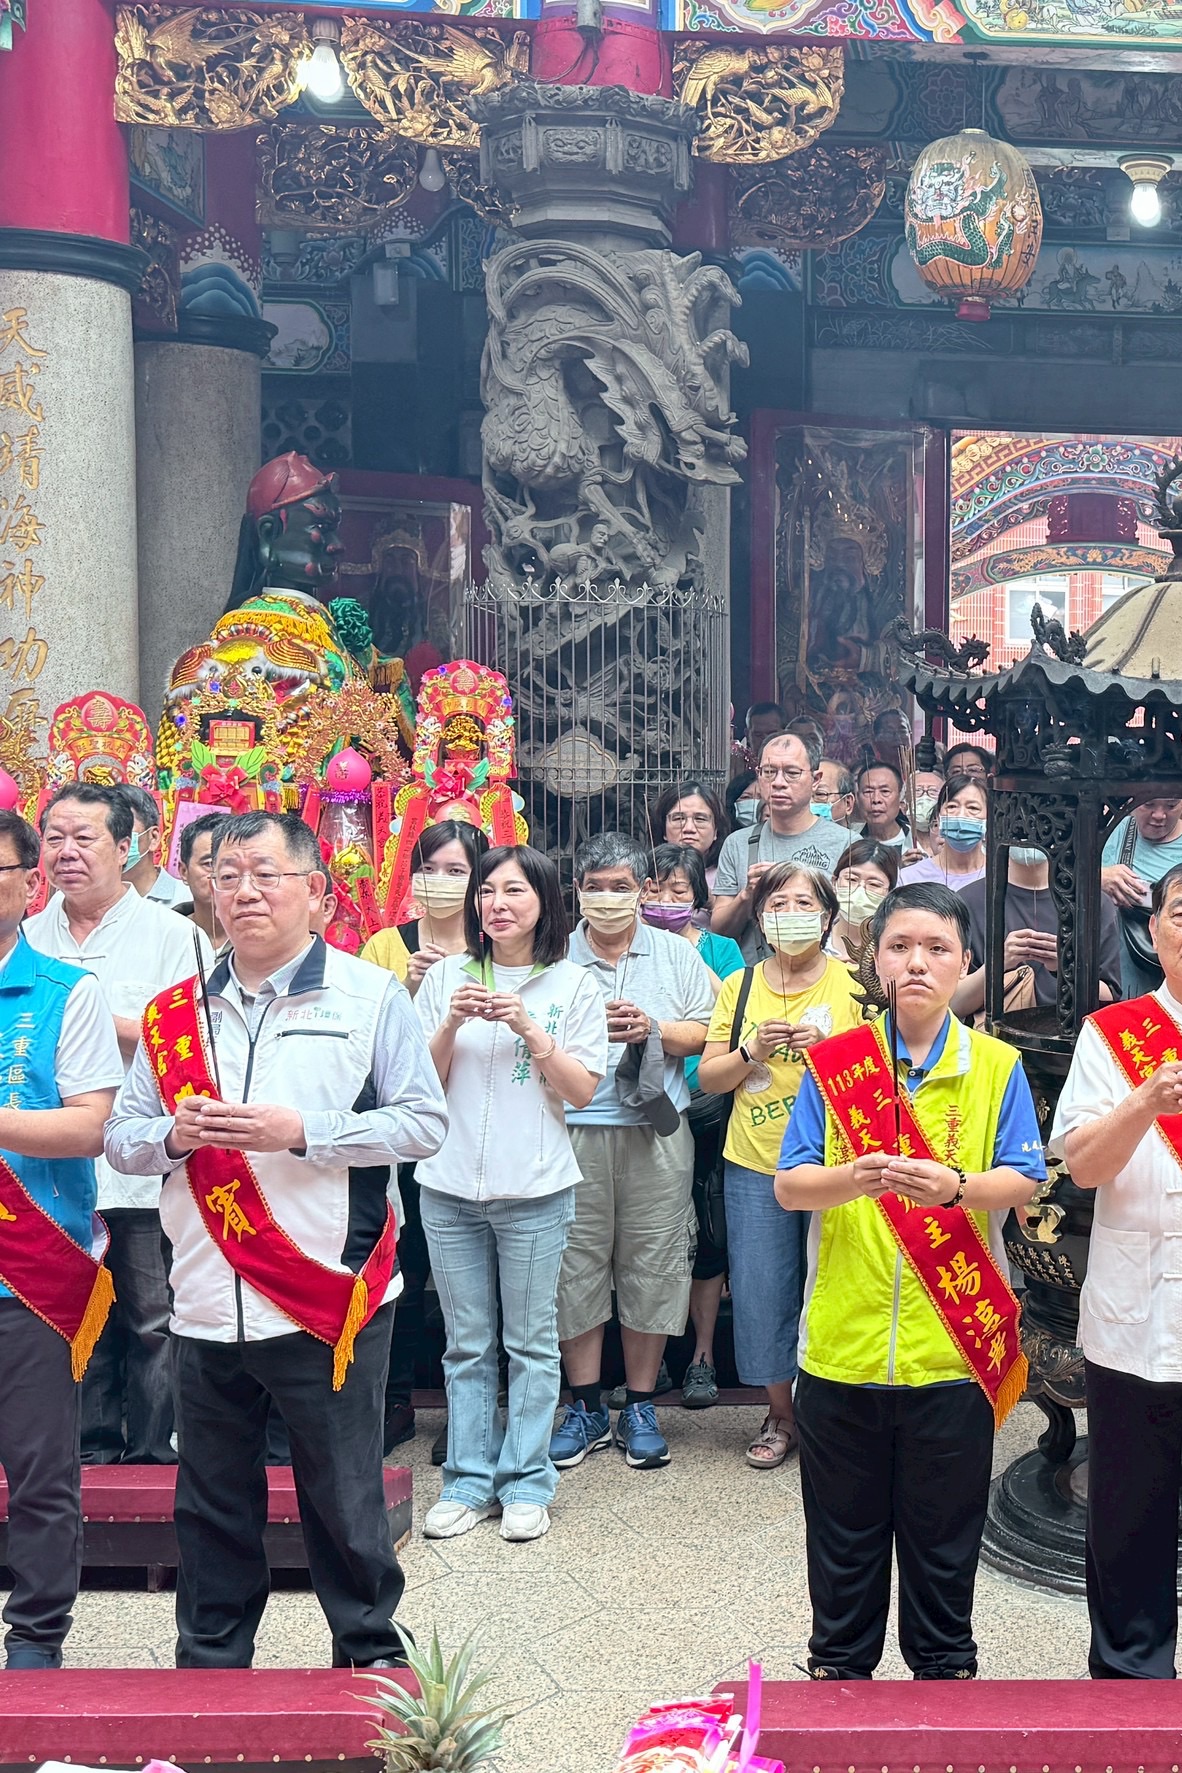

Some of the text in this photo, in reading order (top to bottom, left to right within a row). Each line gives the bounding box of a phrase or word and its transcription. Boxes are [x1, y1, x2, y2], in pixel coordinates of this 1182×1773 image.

[168, 988, 195, 1062] 三重
[6, 1012, 36, 1111] 三重區長
[827, 1055, 881, 1097] 113年度
[847, 1103, 886, 1157] 義天
